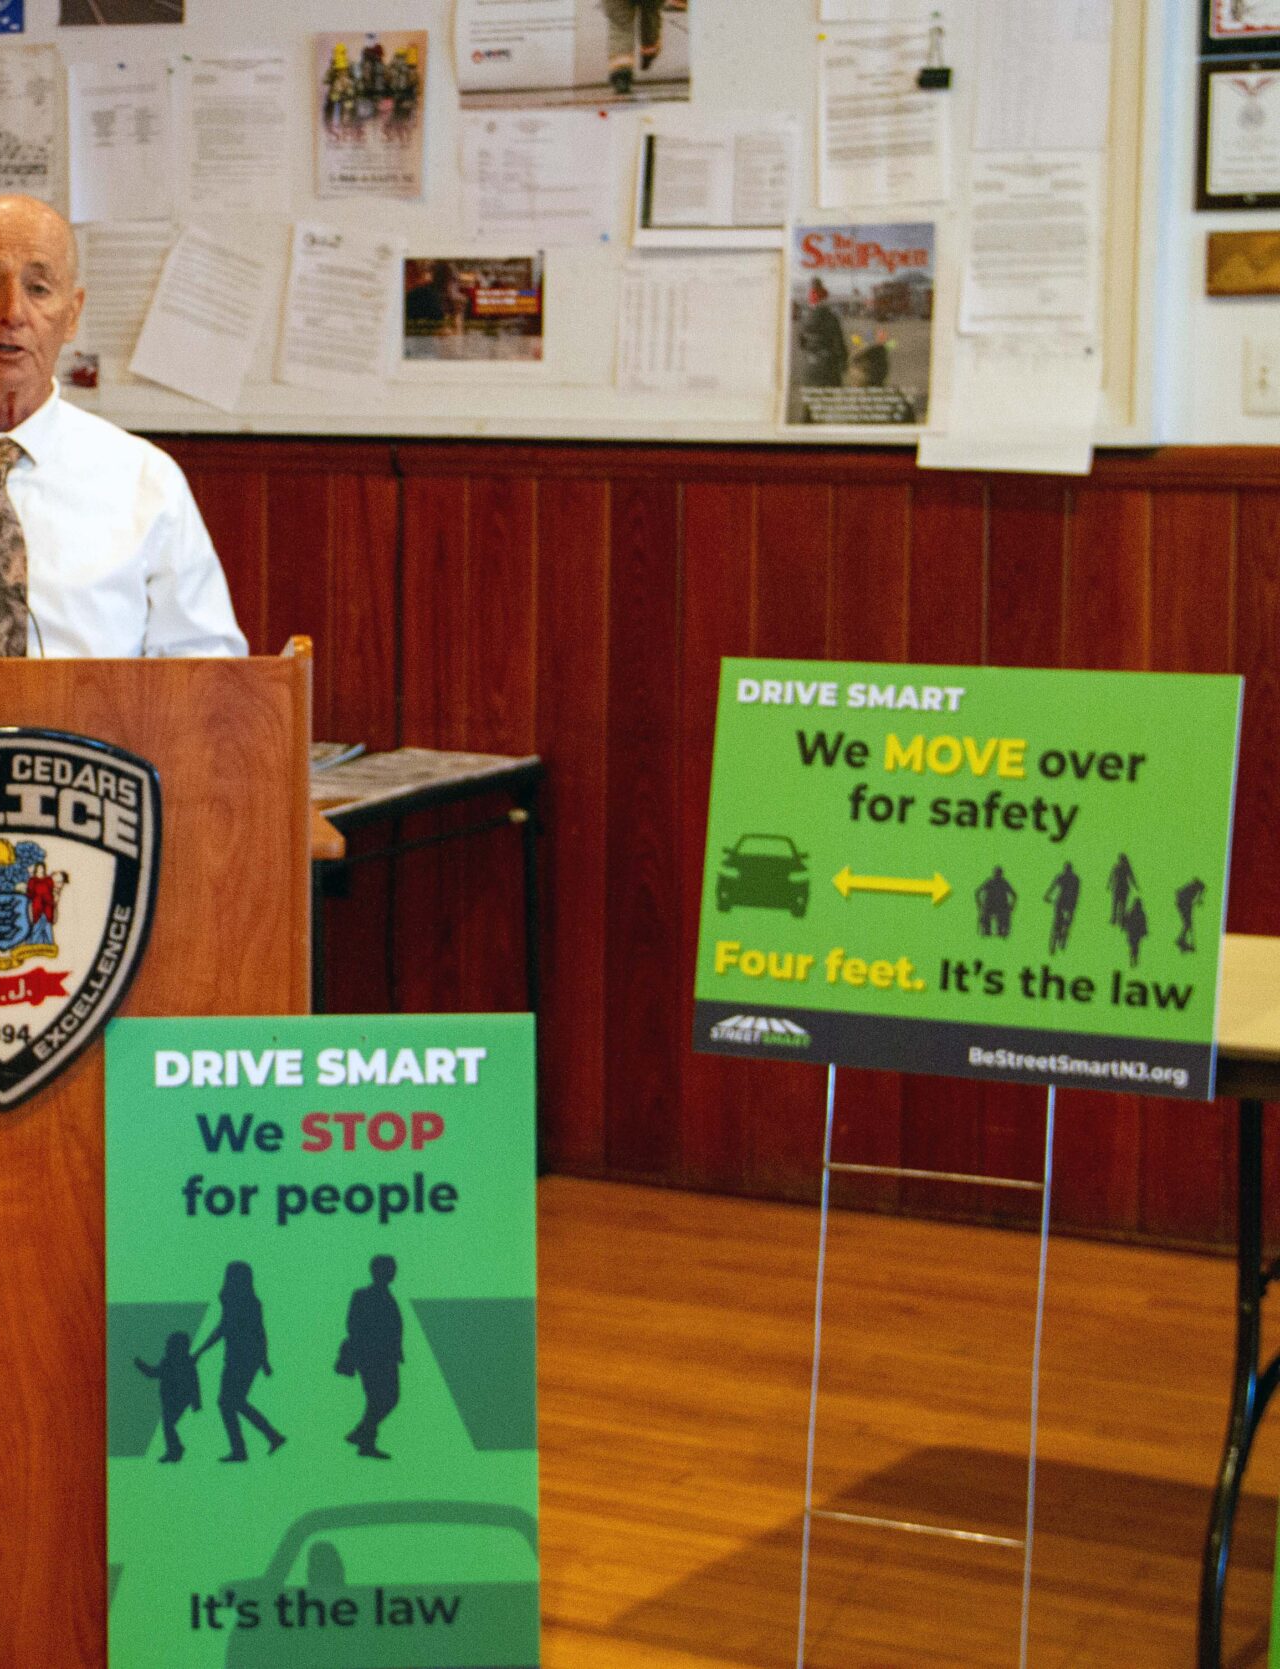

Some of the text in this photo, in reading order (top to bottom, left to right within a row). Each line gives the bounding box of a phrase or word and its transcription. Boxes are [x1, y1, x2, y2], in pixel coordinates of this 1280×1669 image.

[737, 679, 965, 712] DRIVE SMART
[12, 755, 137, 808] CEDARS
[796, 731, 1146, 782] We MOVE over
[849, 783, 1079, 842] for safety
[33, 904, 131, 1061] EXCELLENCE
[714, 941, 814, 982] Four
[826, 948, 926, 992] feet.
[1020, 966, 1095, 1004] the
[1111, 971, 1194, 1011] law
[154, 1047, 487, 1087] DRIVE SMART
[969, 1046, 1189, 1088] BeStreetSmartNJ.org
[196, 1111, 445, 1153] We STOP
[182, 1172, 459, 1226] for people
[275, 1588, 359, 1627] the
[375, 1586, 461, 1627] law
